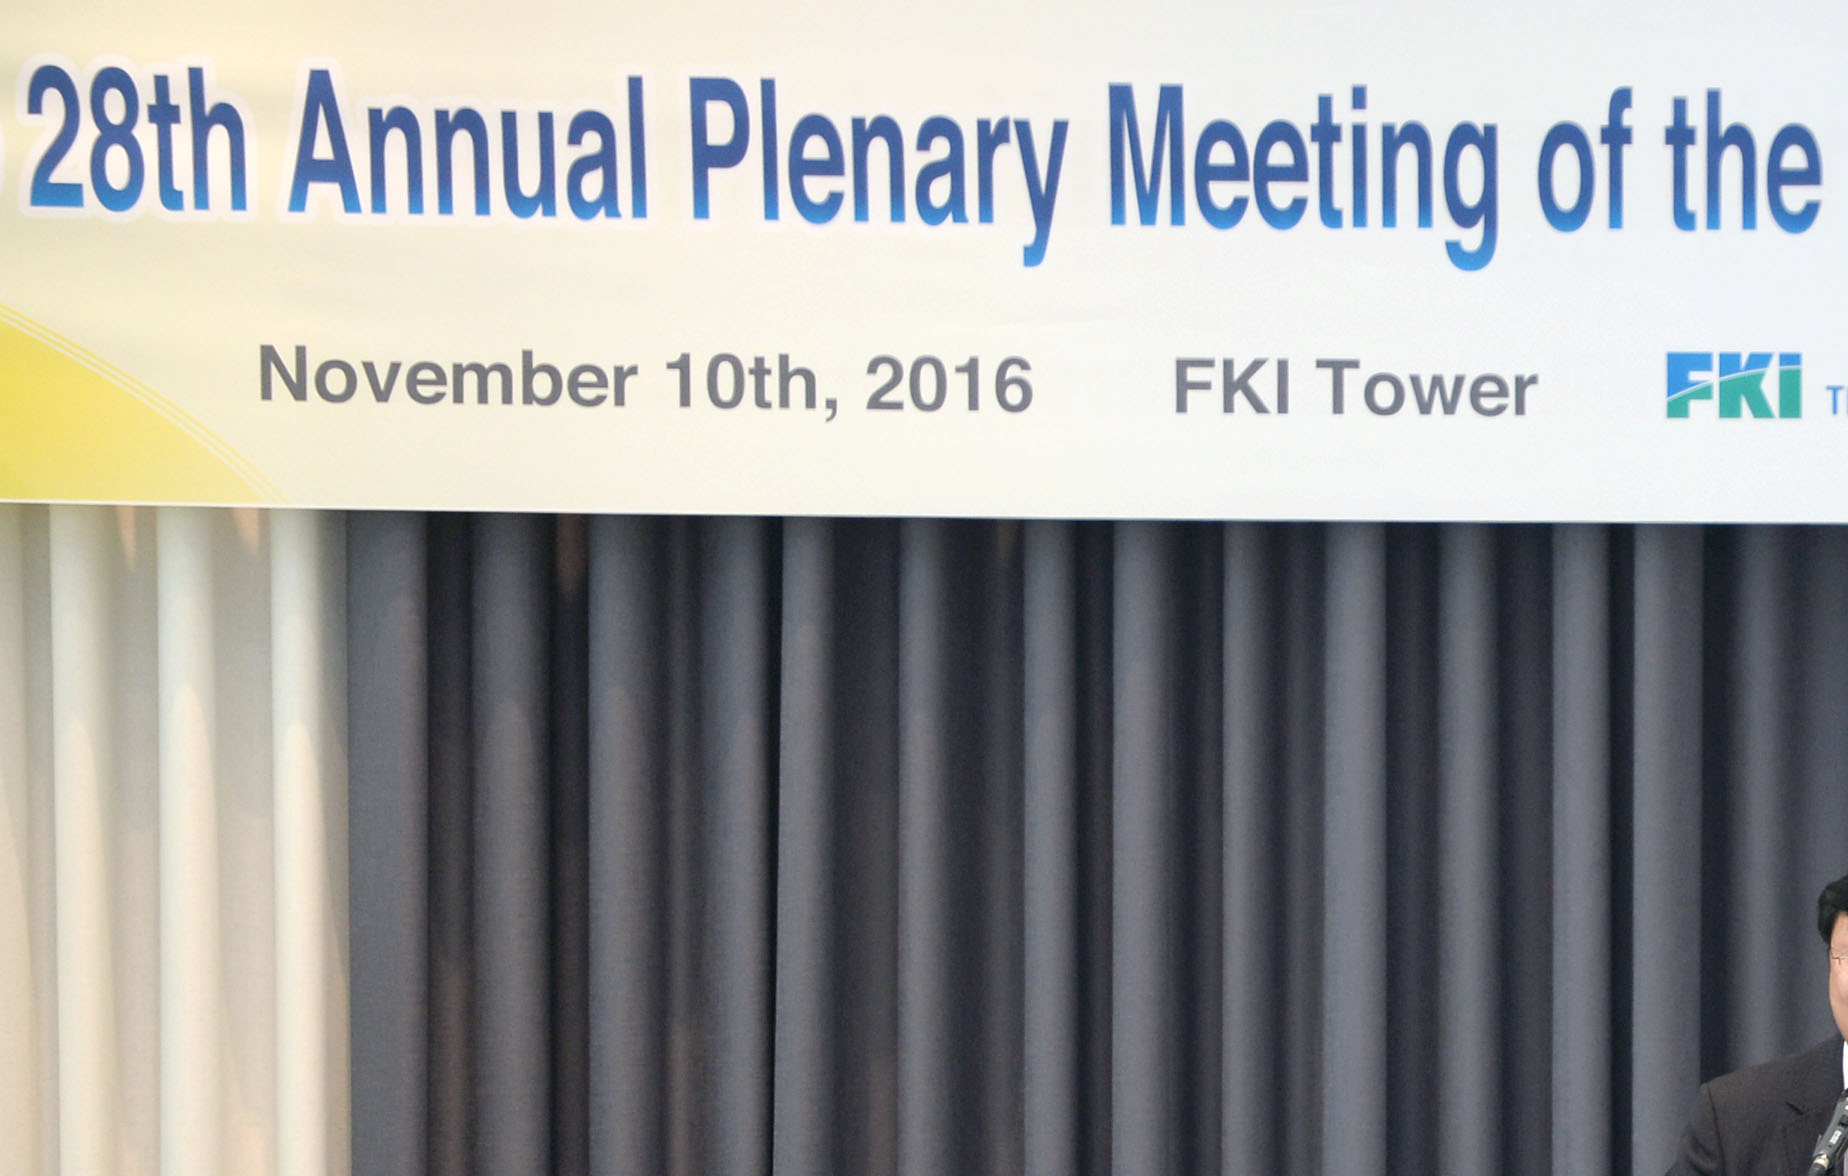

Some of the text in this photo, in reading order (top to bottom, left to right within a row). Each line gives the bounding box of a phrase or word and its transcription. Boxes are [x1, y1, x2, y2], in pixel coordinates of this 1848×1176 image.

[26, 63, 248, 214] 28th
[286, 68, 649, 222] Annual
[688, 76, 1070, 268] Plenary
[1107, 82, 1500, 273] Meeting
[1535, 85, 1634, 234] of
[1663, 87, 1824, 235] the
[258, 343, 1034, 423] November 10th, 2016
[1174, 357, 1539, 418] FKI Tower
[1665, 350, 1804, 421] FKI
